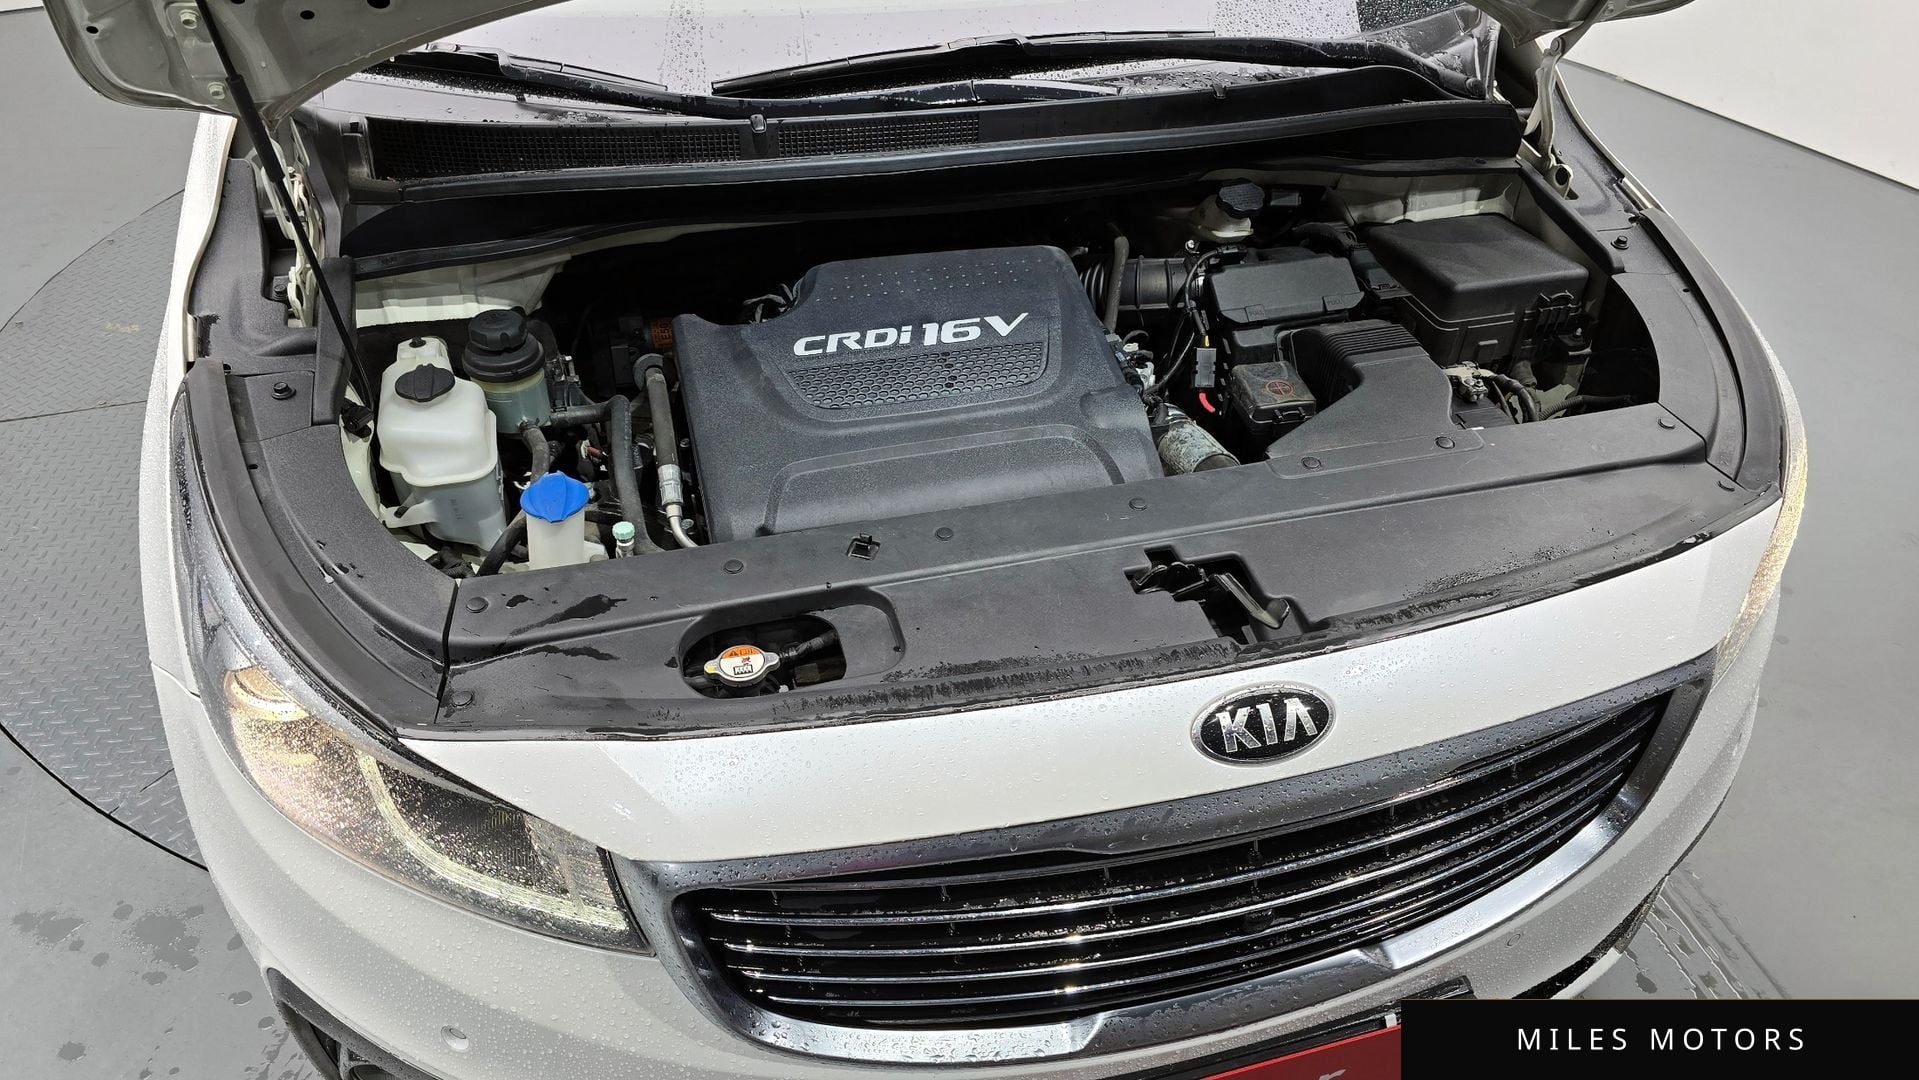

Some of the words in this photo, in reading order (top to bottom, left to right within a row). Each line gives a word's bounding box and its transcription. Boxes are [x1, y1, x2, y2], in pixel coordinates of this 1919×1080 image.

[793, 325, 913, 356] CRDi
[922, 312, 1029, 346] 16V
[1215, 697, 1318, 753] KIA
